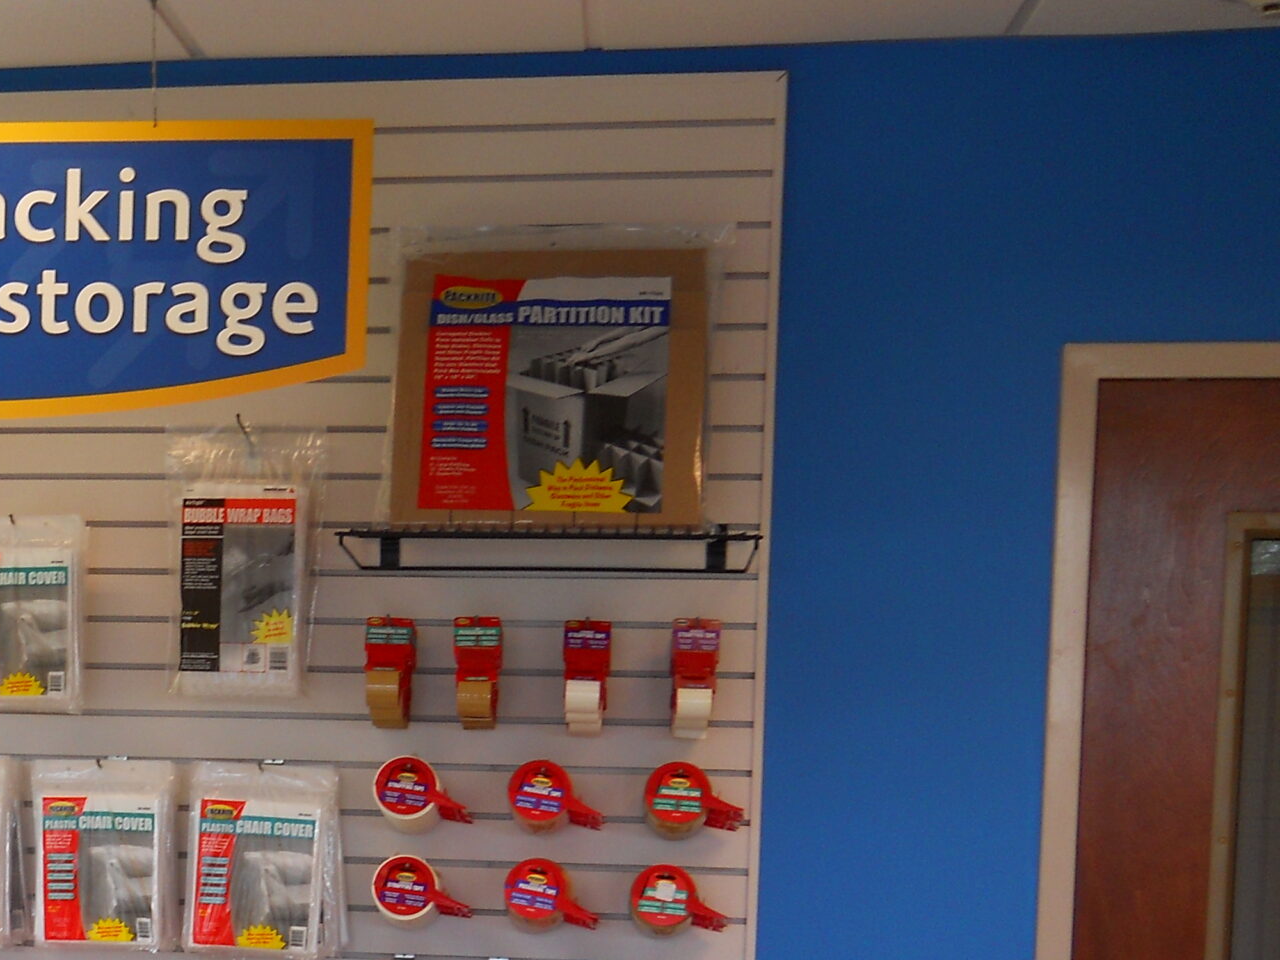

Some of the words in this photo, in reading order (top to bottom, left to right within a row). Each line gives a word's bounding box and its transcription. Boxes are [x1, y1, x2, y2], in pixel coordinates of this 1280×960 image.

[436, 312, 513, 325] DISH/GLASS
[517, 306, 626, 324] PARTITION
[628, 306, 664, 324] KIT
[183, 508, 225, 523] BUBBLE
[226, 508, 263, 523] WRAP
[263, 508, 293, 523] BAGS
[28, 571, 65, 585] COVER
[78, 814, 112, 830] CHAIR
[115, 814, 152, 831] COVER
[201, 822, 235, 834] PLASTIC
[236, 819, 272, 836] CHAIR
[275, 821, 313, 838] COVER
